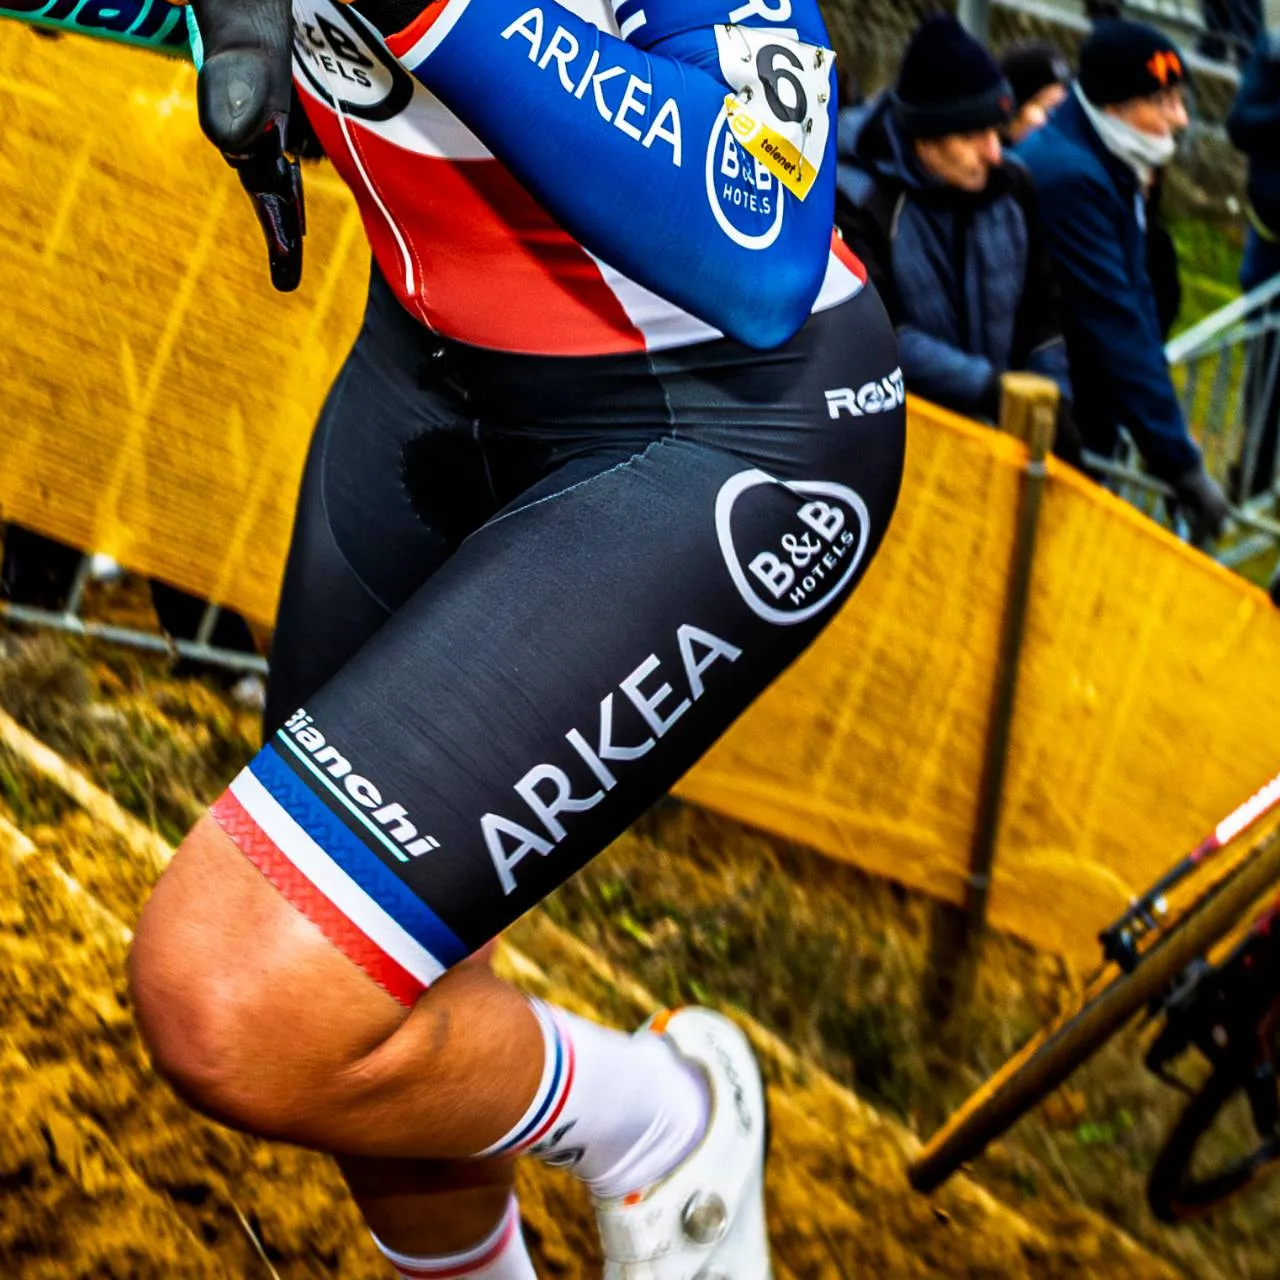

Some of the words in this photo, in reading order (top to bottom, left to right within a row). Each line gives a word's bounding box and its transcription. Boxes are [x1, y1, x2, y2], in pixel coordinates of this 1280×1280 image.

[500, 6, 684, 167] ARKEA
[756, 43, 808, 124] 6
[760, 138, 797, 176] telenet
[824, 366, 905, 420] ROST
[747, 499, 847, 600] B&B
[789, 526, 857, 606] HOTELS
[480, 622, 743, 897] ARKEA
